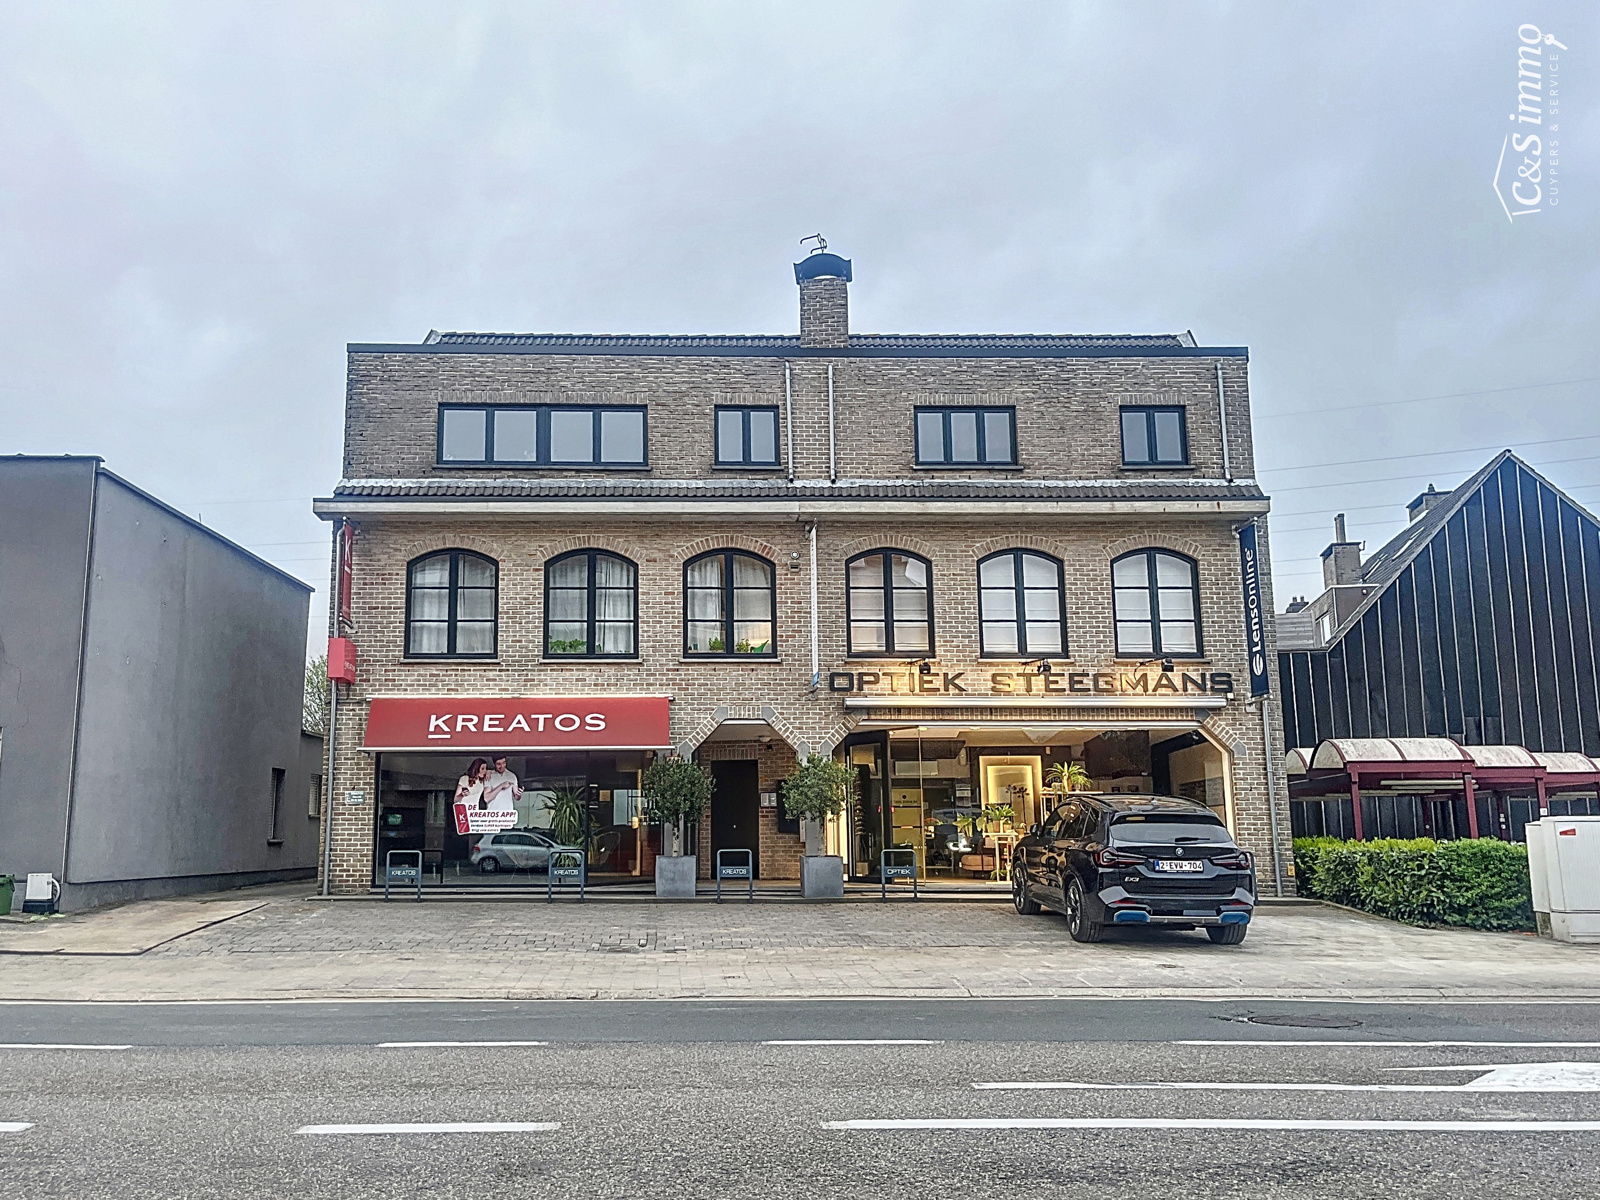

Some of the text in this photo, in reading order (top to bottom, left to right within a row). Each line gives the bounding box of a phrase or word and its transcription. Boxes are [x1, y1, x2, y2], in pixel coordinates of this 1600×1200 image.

[829, 672, 1234, 693] OPTIEK STEEGMANS
[428, 713, 606, 738] KREATOS
